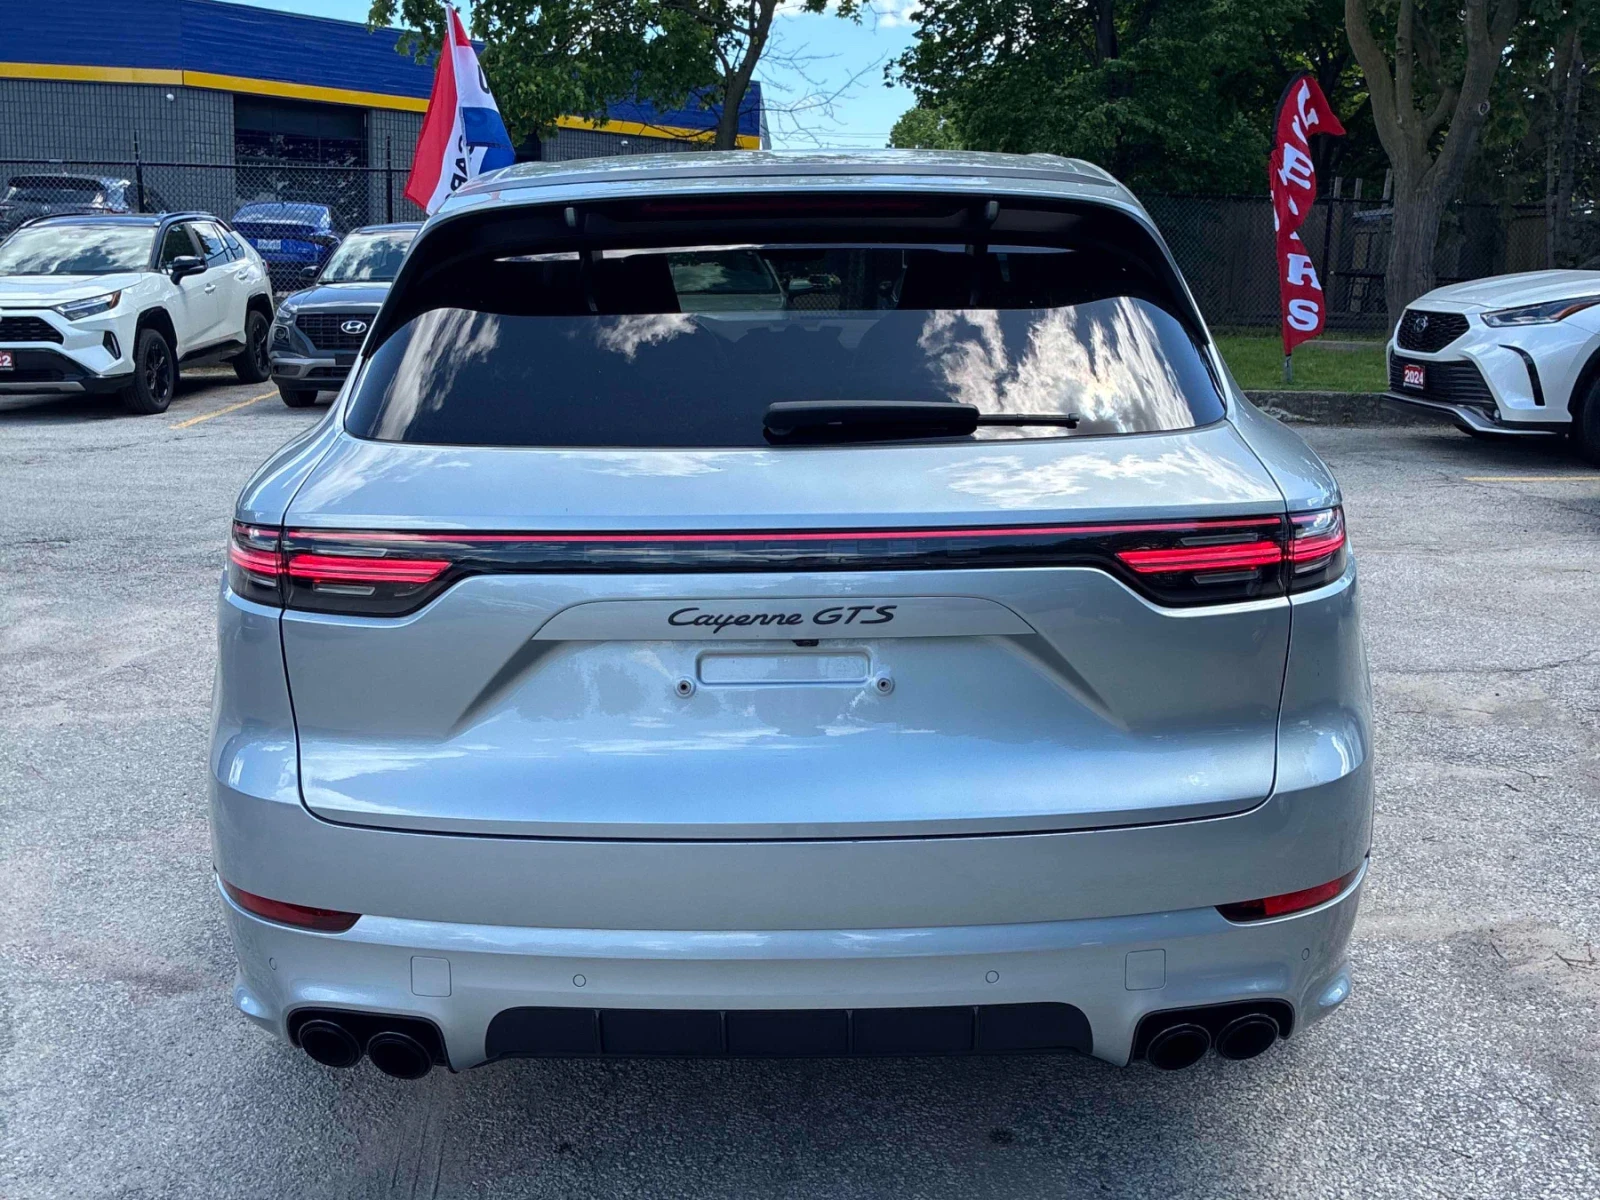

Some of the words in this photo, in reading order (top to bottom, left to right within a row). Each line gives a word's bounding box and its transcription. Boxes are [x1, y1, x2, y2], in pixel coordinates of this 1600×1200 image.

[1404, 369, 1424, 385] 2024
[667, 607, 804, 634] Cayenne
[812, 604, 898, 625] GTS
